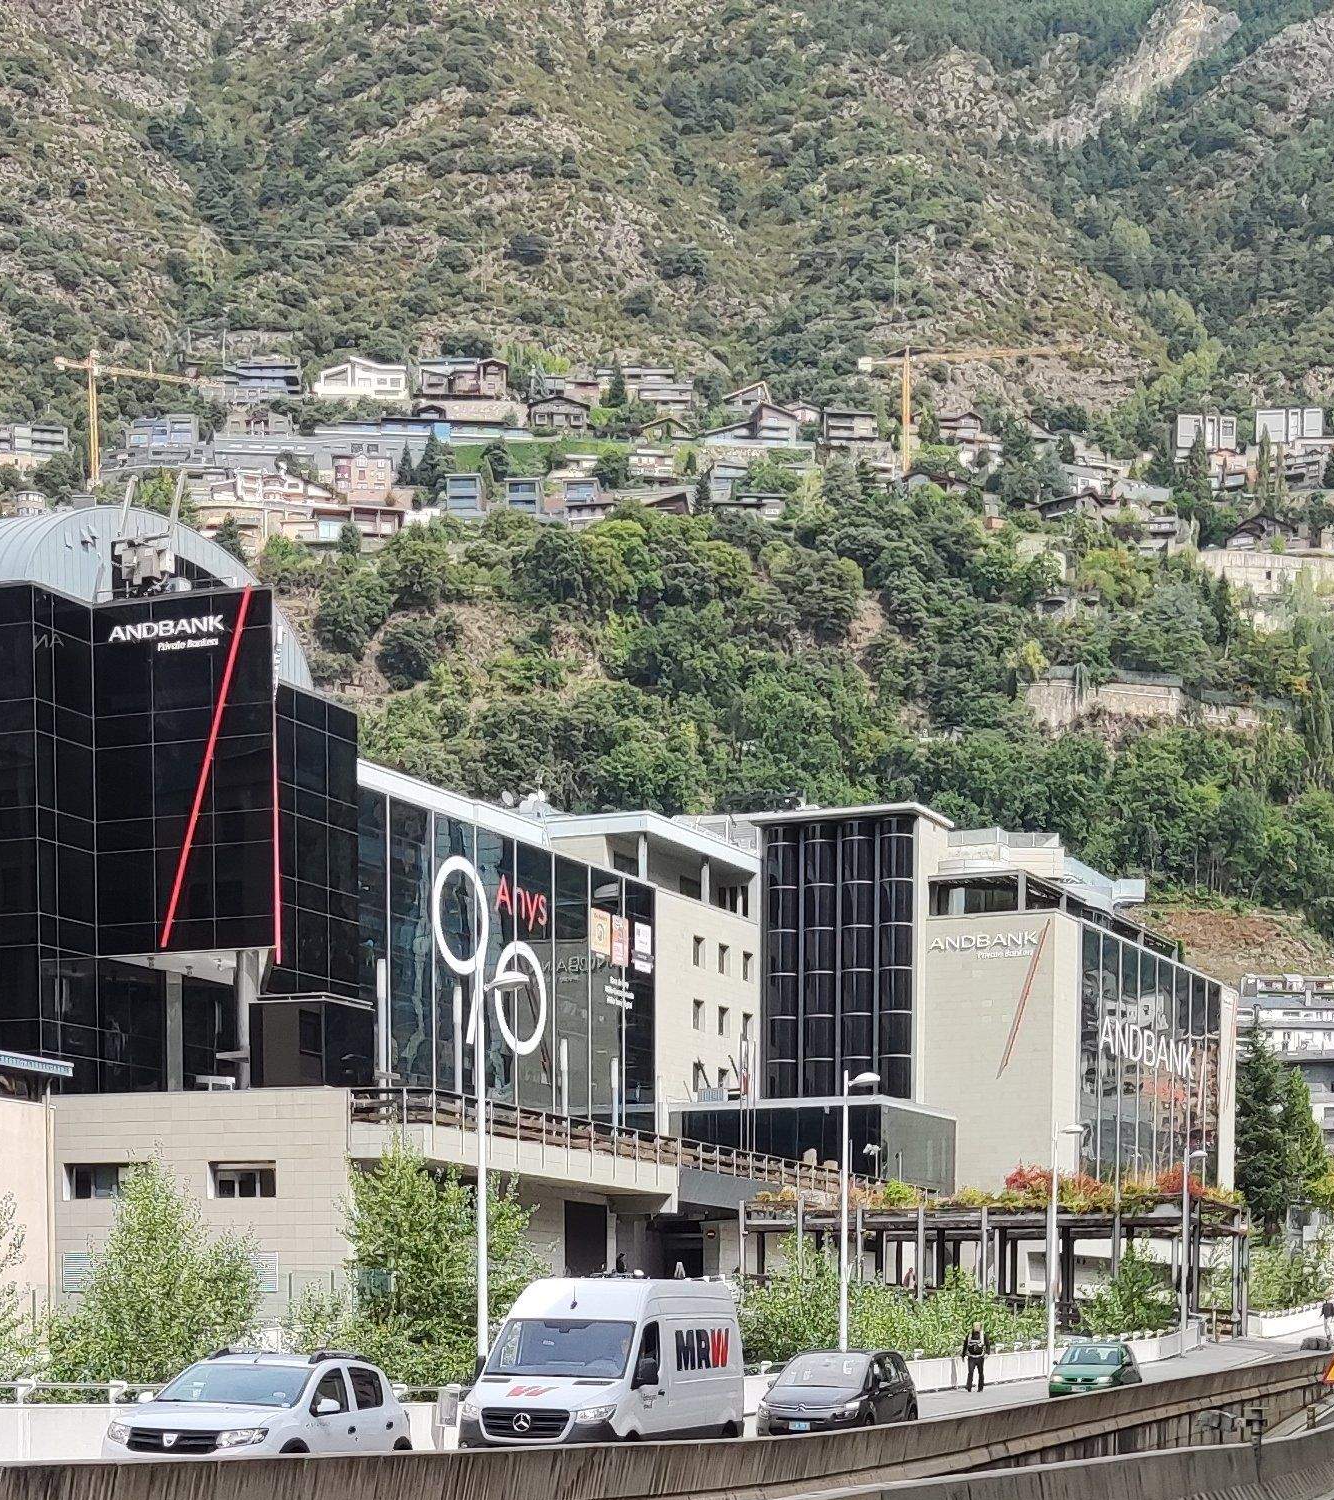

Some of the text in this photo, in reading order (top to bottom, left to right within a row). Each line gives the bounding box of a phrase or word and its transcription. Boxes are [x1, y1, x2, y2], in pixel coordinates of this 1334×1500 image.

[108, 614, 225, 643] ANDBANK
[495, 874, 548, 933] Anys
[928, 930, 1039, 953] ANDBANK
[1099, 1015, 1195, 1080] ANDBANK
[675, 1327, 730, 1371] MRW
